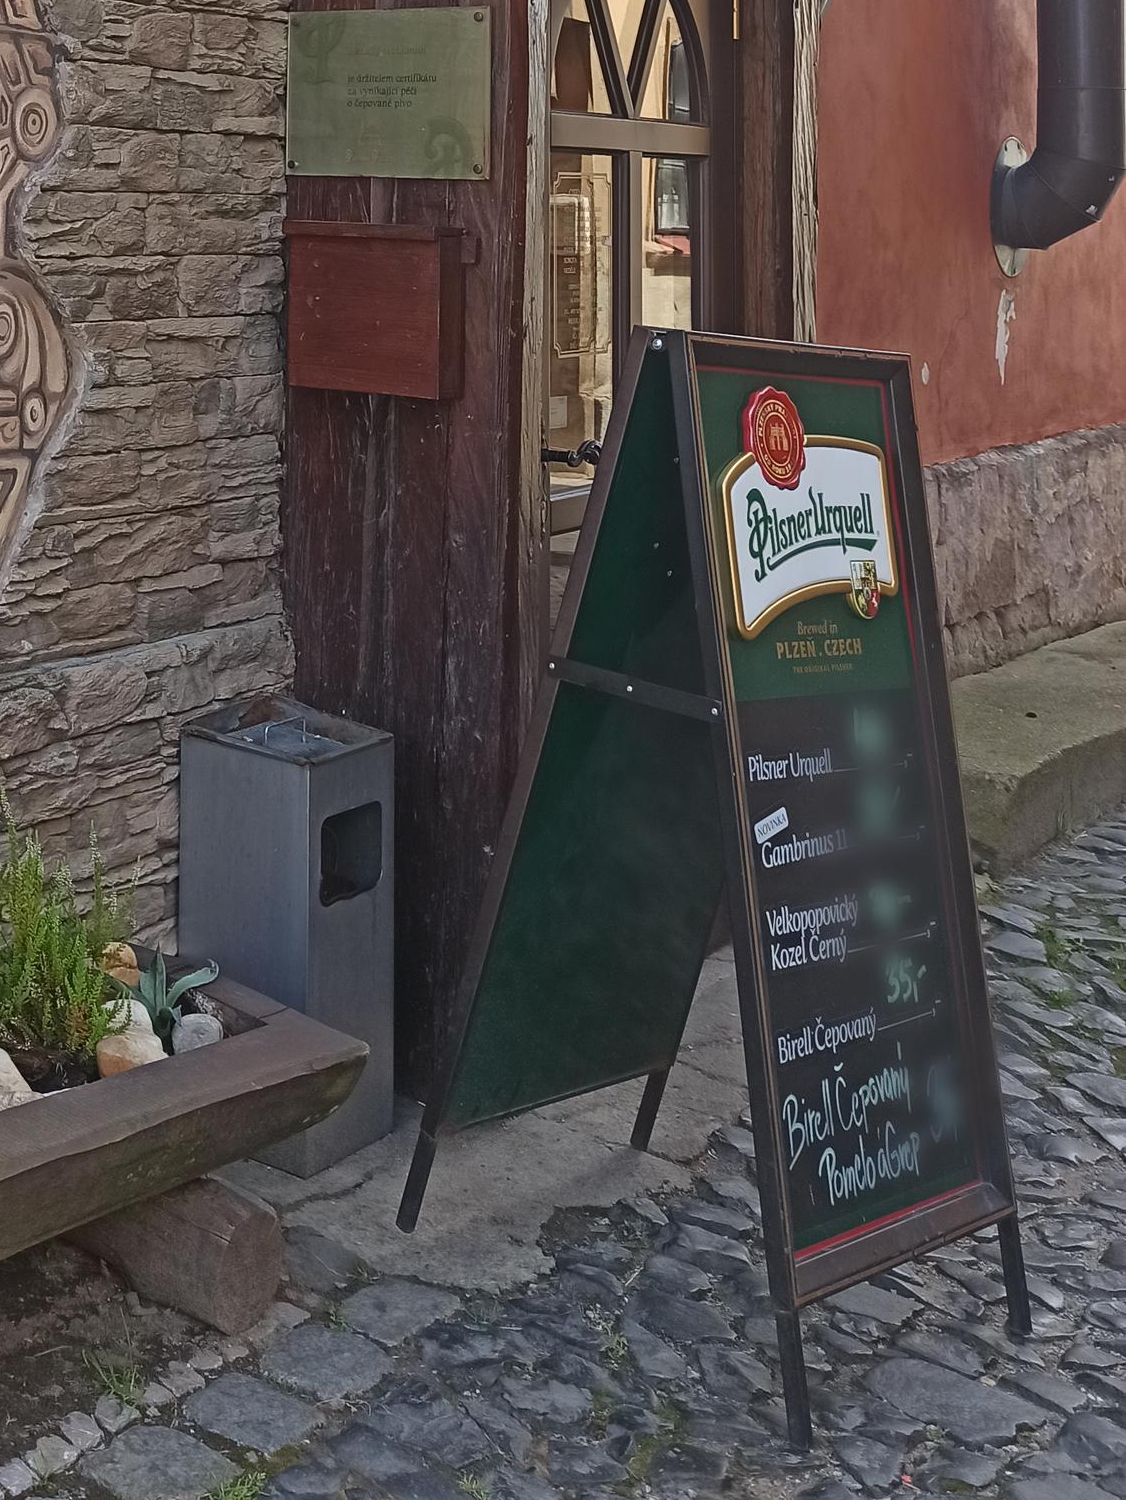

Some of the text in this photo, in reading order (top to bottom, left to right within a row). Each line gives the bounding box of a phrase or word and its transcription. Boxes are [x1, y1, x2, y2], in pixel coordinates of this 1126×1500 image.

[746, 485, 875, 583] Pilsner Urquell
[776, 636, 862, 660] PLZEŇ CZECH
[797, 619, 838, 635] Brewed in
[748, 747, 833, 783] Pilsner Urquell
[757, 812, 787, 839] NOVINKA
[761, 831, 834, 869] Gambrinus
[765, 893, 858, 937] Velkopopovický
[770, 927, 847, 971] Kozel Černý
[777, 1005, 877, 1064] Birell Čepovaný
[782, 1078, 835, 1172] Birell
[835, 1041, 912, 1135] Čepovaný
[818, 1134, 876, 1206] Pomelo
